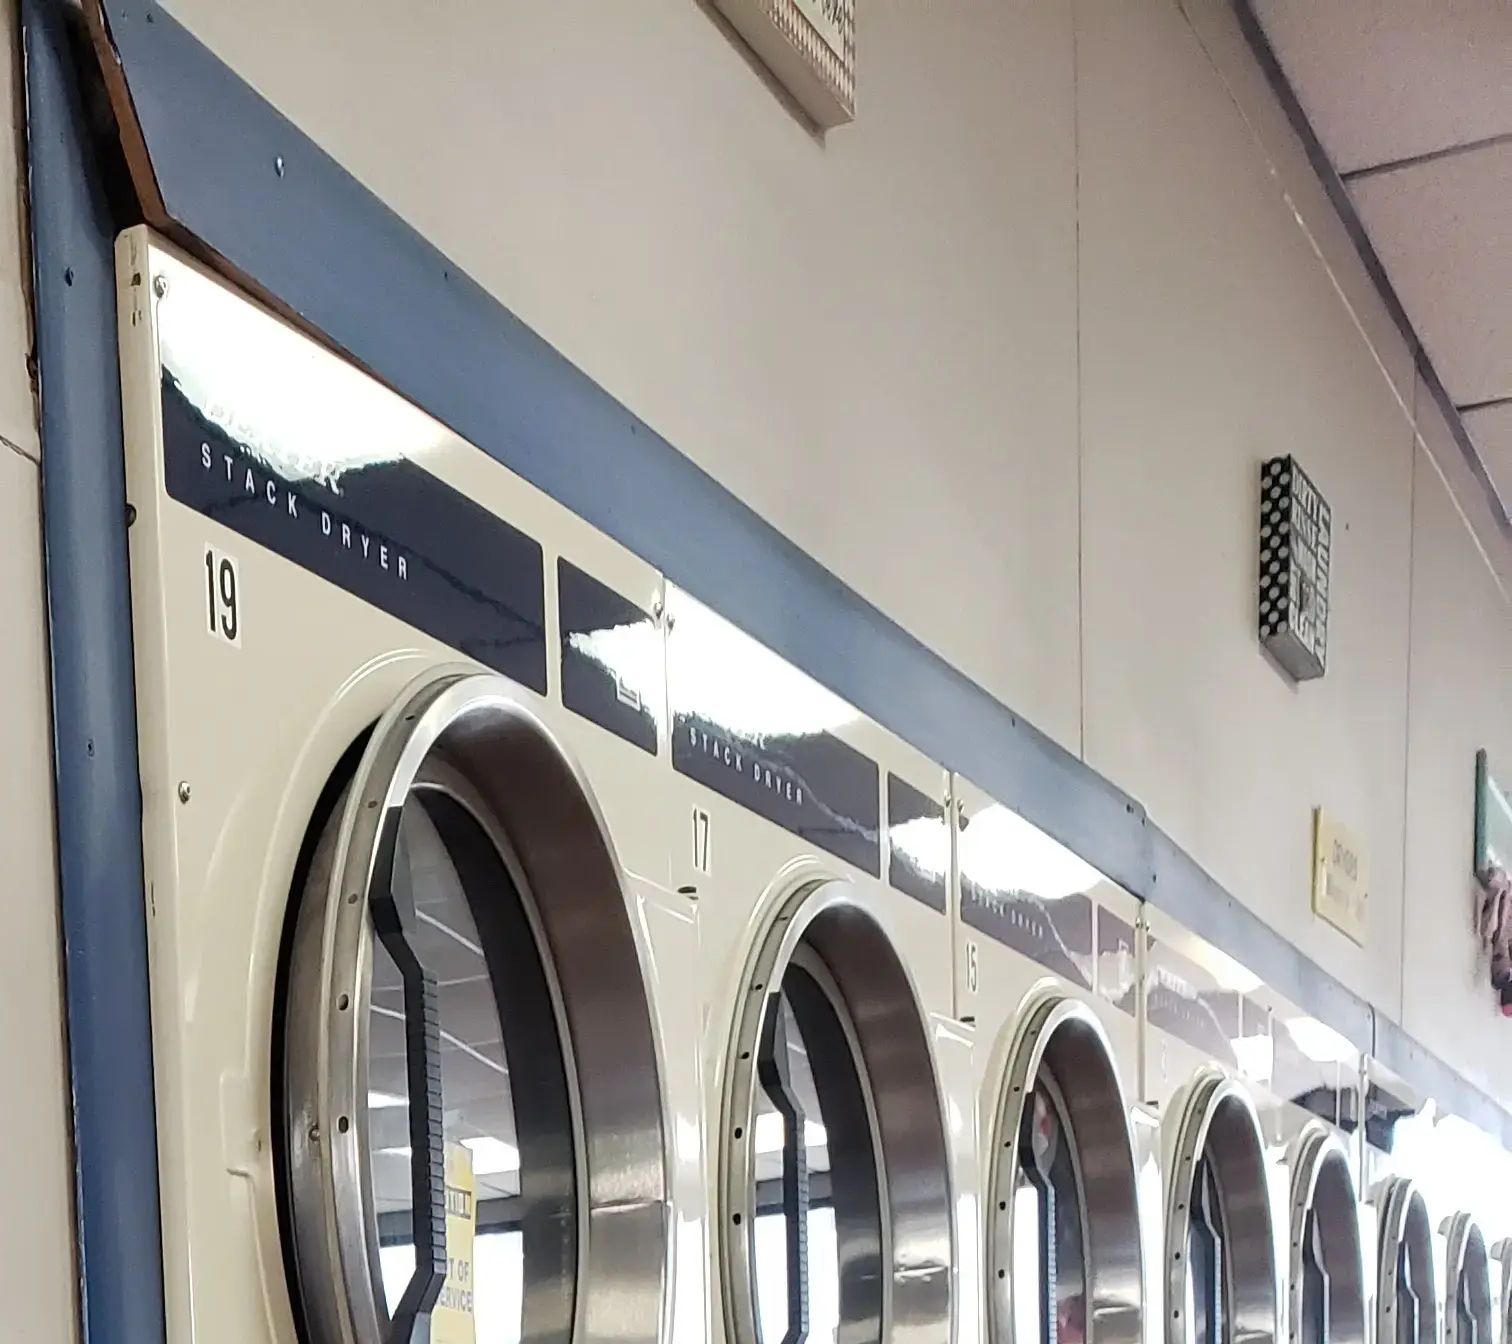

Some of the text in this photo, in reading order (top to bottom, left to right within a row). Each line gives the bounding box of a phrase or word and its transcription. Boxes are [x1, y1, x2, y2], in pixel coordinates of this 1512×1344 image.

[201, 442, 297, 518] STACK
[321, 511, 407, 580] DRYER
[206, 550, 237, 640] 19
[691, 727, 742, 772] STACK
[754, 763, 802, 805] DRYER
[693, 808, 708, 872] 17
[966, 942, 977, 992] 15
[457, 1259, 470, 1282] OF
